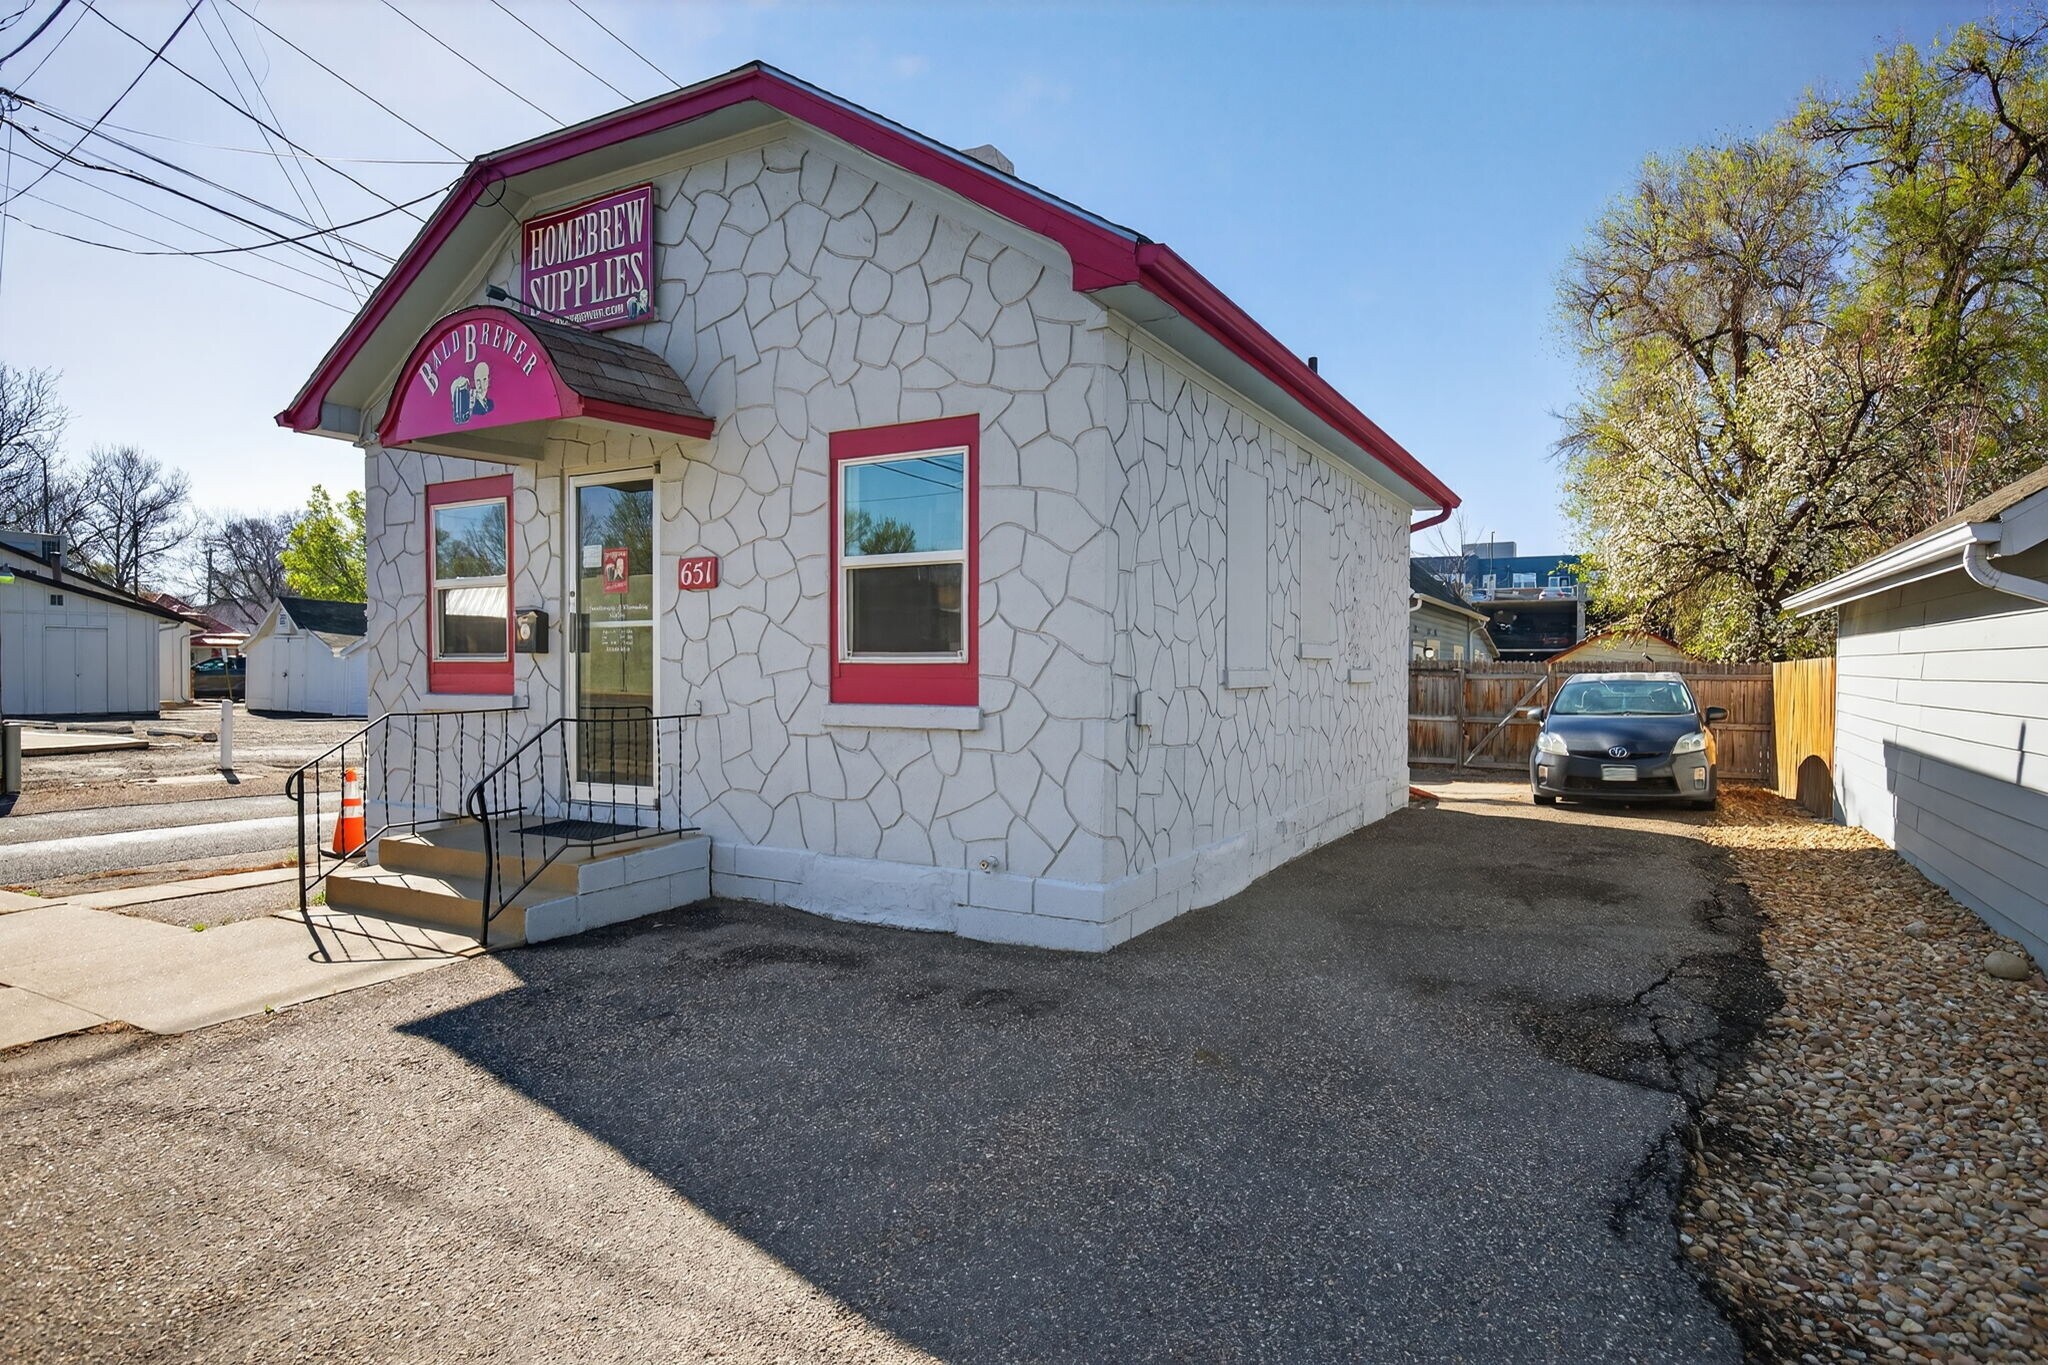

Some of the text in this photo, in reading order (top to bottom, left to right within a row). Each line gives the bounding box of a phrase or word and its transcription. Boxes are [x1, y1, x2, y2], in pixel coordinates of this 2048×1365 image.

[530, 197, 646, 271] HOMEBREW
[530, 251, 643, 317] SUPPLIES
[420, 322, 537, 397] BALD BREWER
[680, 560, 711, 586] 651
